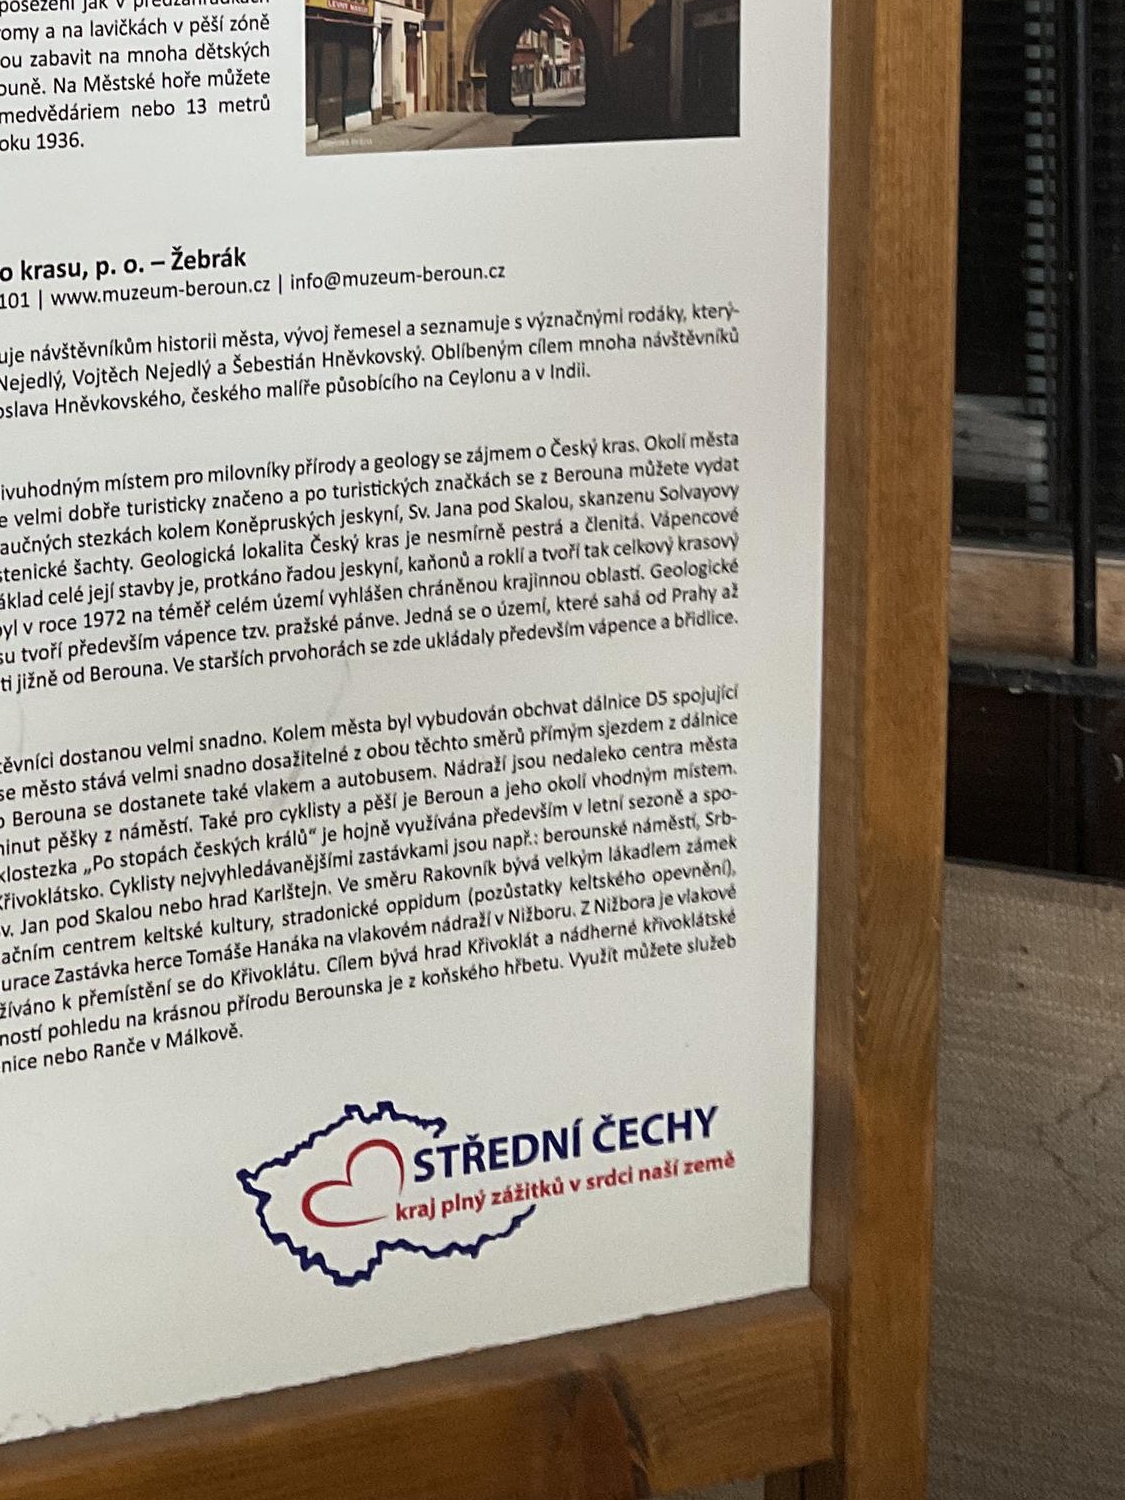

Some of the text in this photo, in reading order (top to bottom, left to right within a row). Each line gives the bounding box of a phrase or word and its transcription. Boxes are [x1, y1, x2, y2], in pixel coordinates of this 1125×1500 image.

[36, 131, 85, 150] 1936.
[20, 259, 88, 281] krasu,
[96, 259, 116, 282] p.
[123, 258, 144, 274] o.
[171, 245, 247, 271] Žebrák
[50, 279, 271, 307] www.muzeum-beroun.cz
[290, 265, 506, 291] info@muzeum-beroun.cz
[30, 336, 152, 363] návštěvníkům
[157, 332, 217, 353] historii
[222, 329, 279, 349] města,
[283, 324, 329, 348] vývoj
[334, 319, 401, 341] řemesel
[406, 323, 415, 336] a
[420, 314, 510, 336] seznamuje
[514, 316, 523, 330] s
[526, 307, 623, 332] význačnými
[628, 304, 687, 325] rodáky,
[692, 301, 740, 322] který-
[43, 1046, 88, 1068] nebo
[93, 1036, 146, 1060] Ranče
[150, 1037, 161, 1051] v
[166, 1021, 243, 1049] Málkově.
[413, 1106, 719, 1183] STŘEDNÍ ČECHY
[396, 1151, 736, 1221] kraj plný zážitků v srdci naší země
